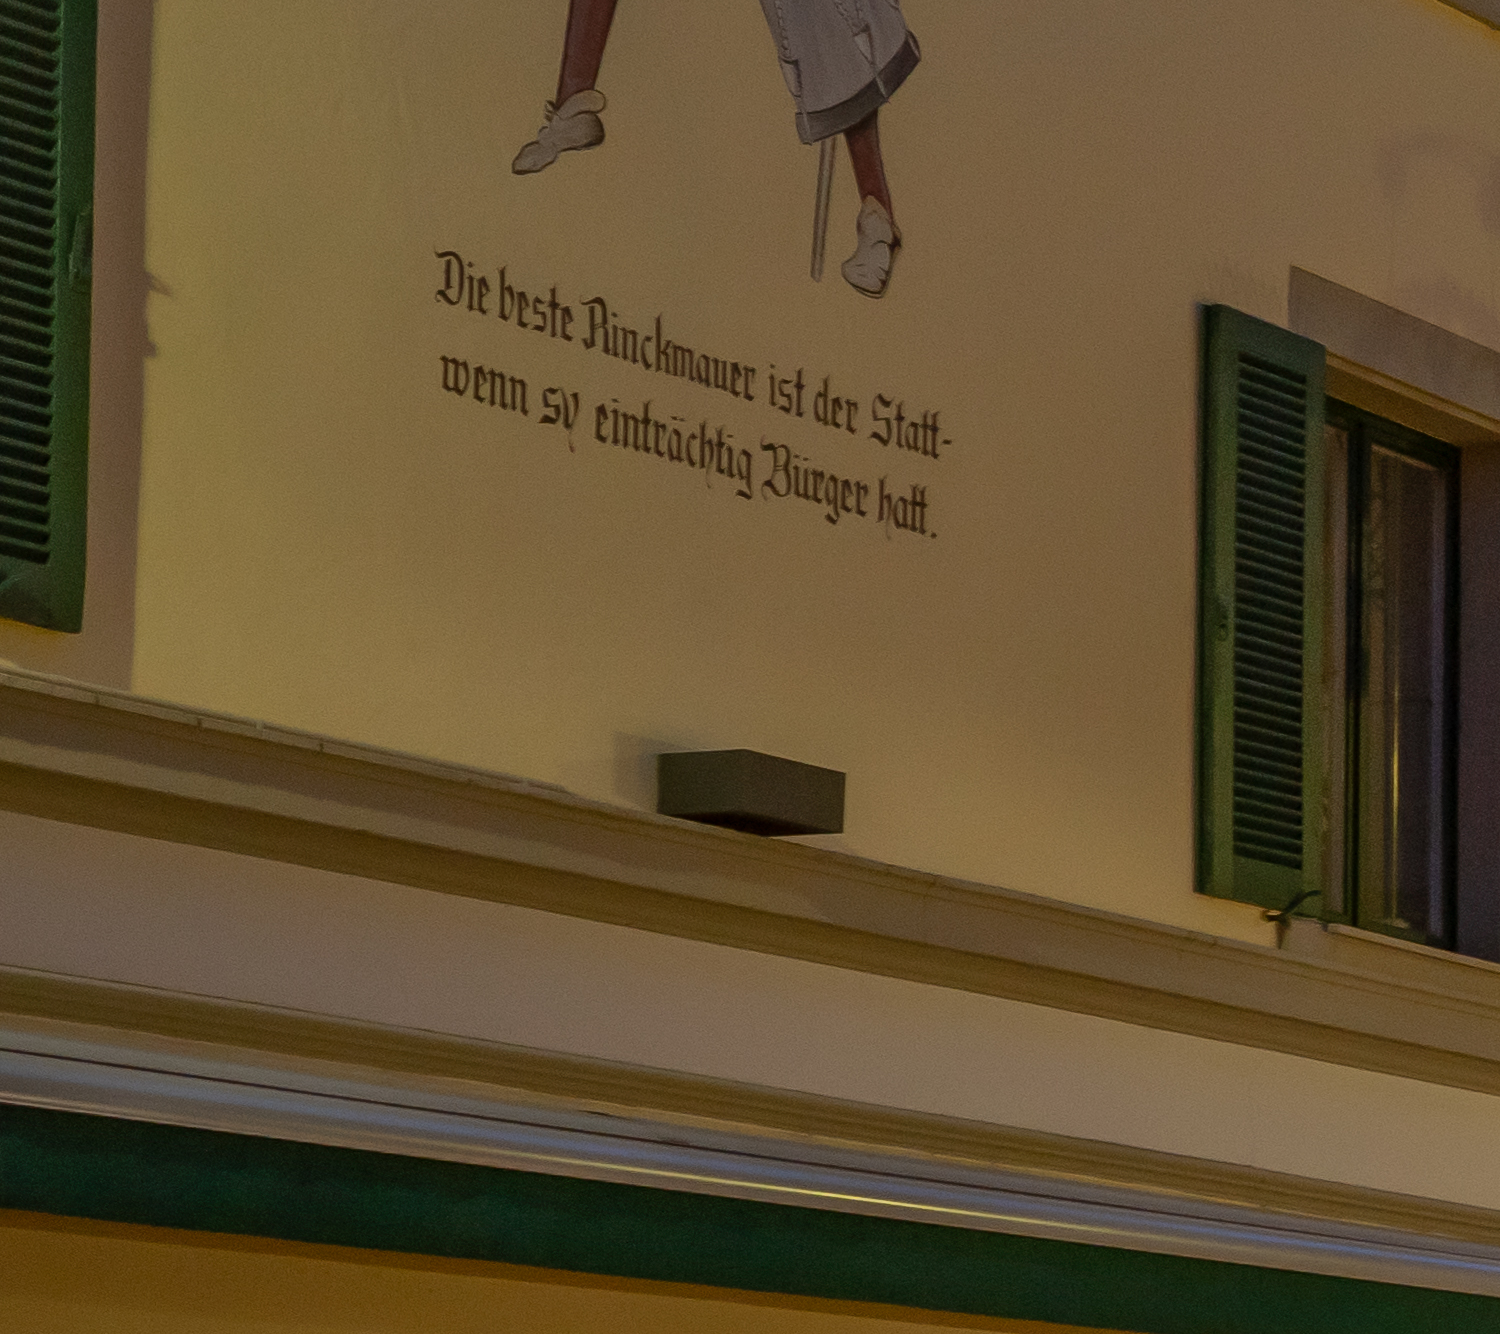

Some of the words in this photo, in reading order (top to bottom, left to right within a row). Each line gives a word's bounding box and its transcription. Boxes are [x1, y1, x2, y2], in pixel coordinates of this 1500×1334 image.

[434, 249, 490, 315] Die
[498, 265, 573, 342] beste
[580, 296, 756, 402] Rinckmauer
[768, 363, 805, 418] ist
[813, 374, 858, 435] der
[439, 354, 529, 417] wenn
[593, 397, 753, 501] einträchtig
[760, 434, 868, 525] Bürger
